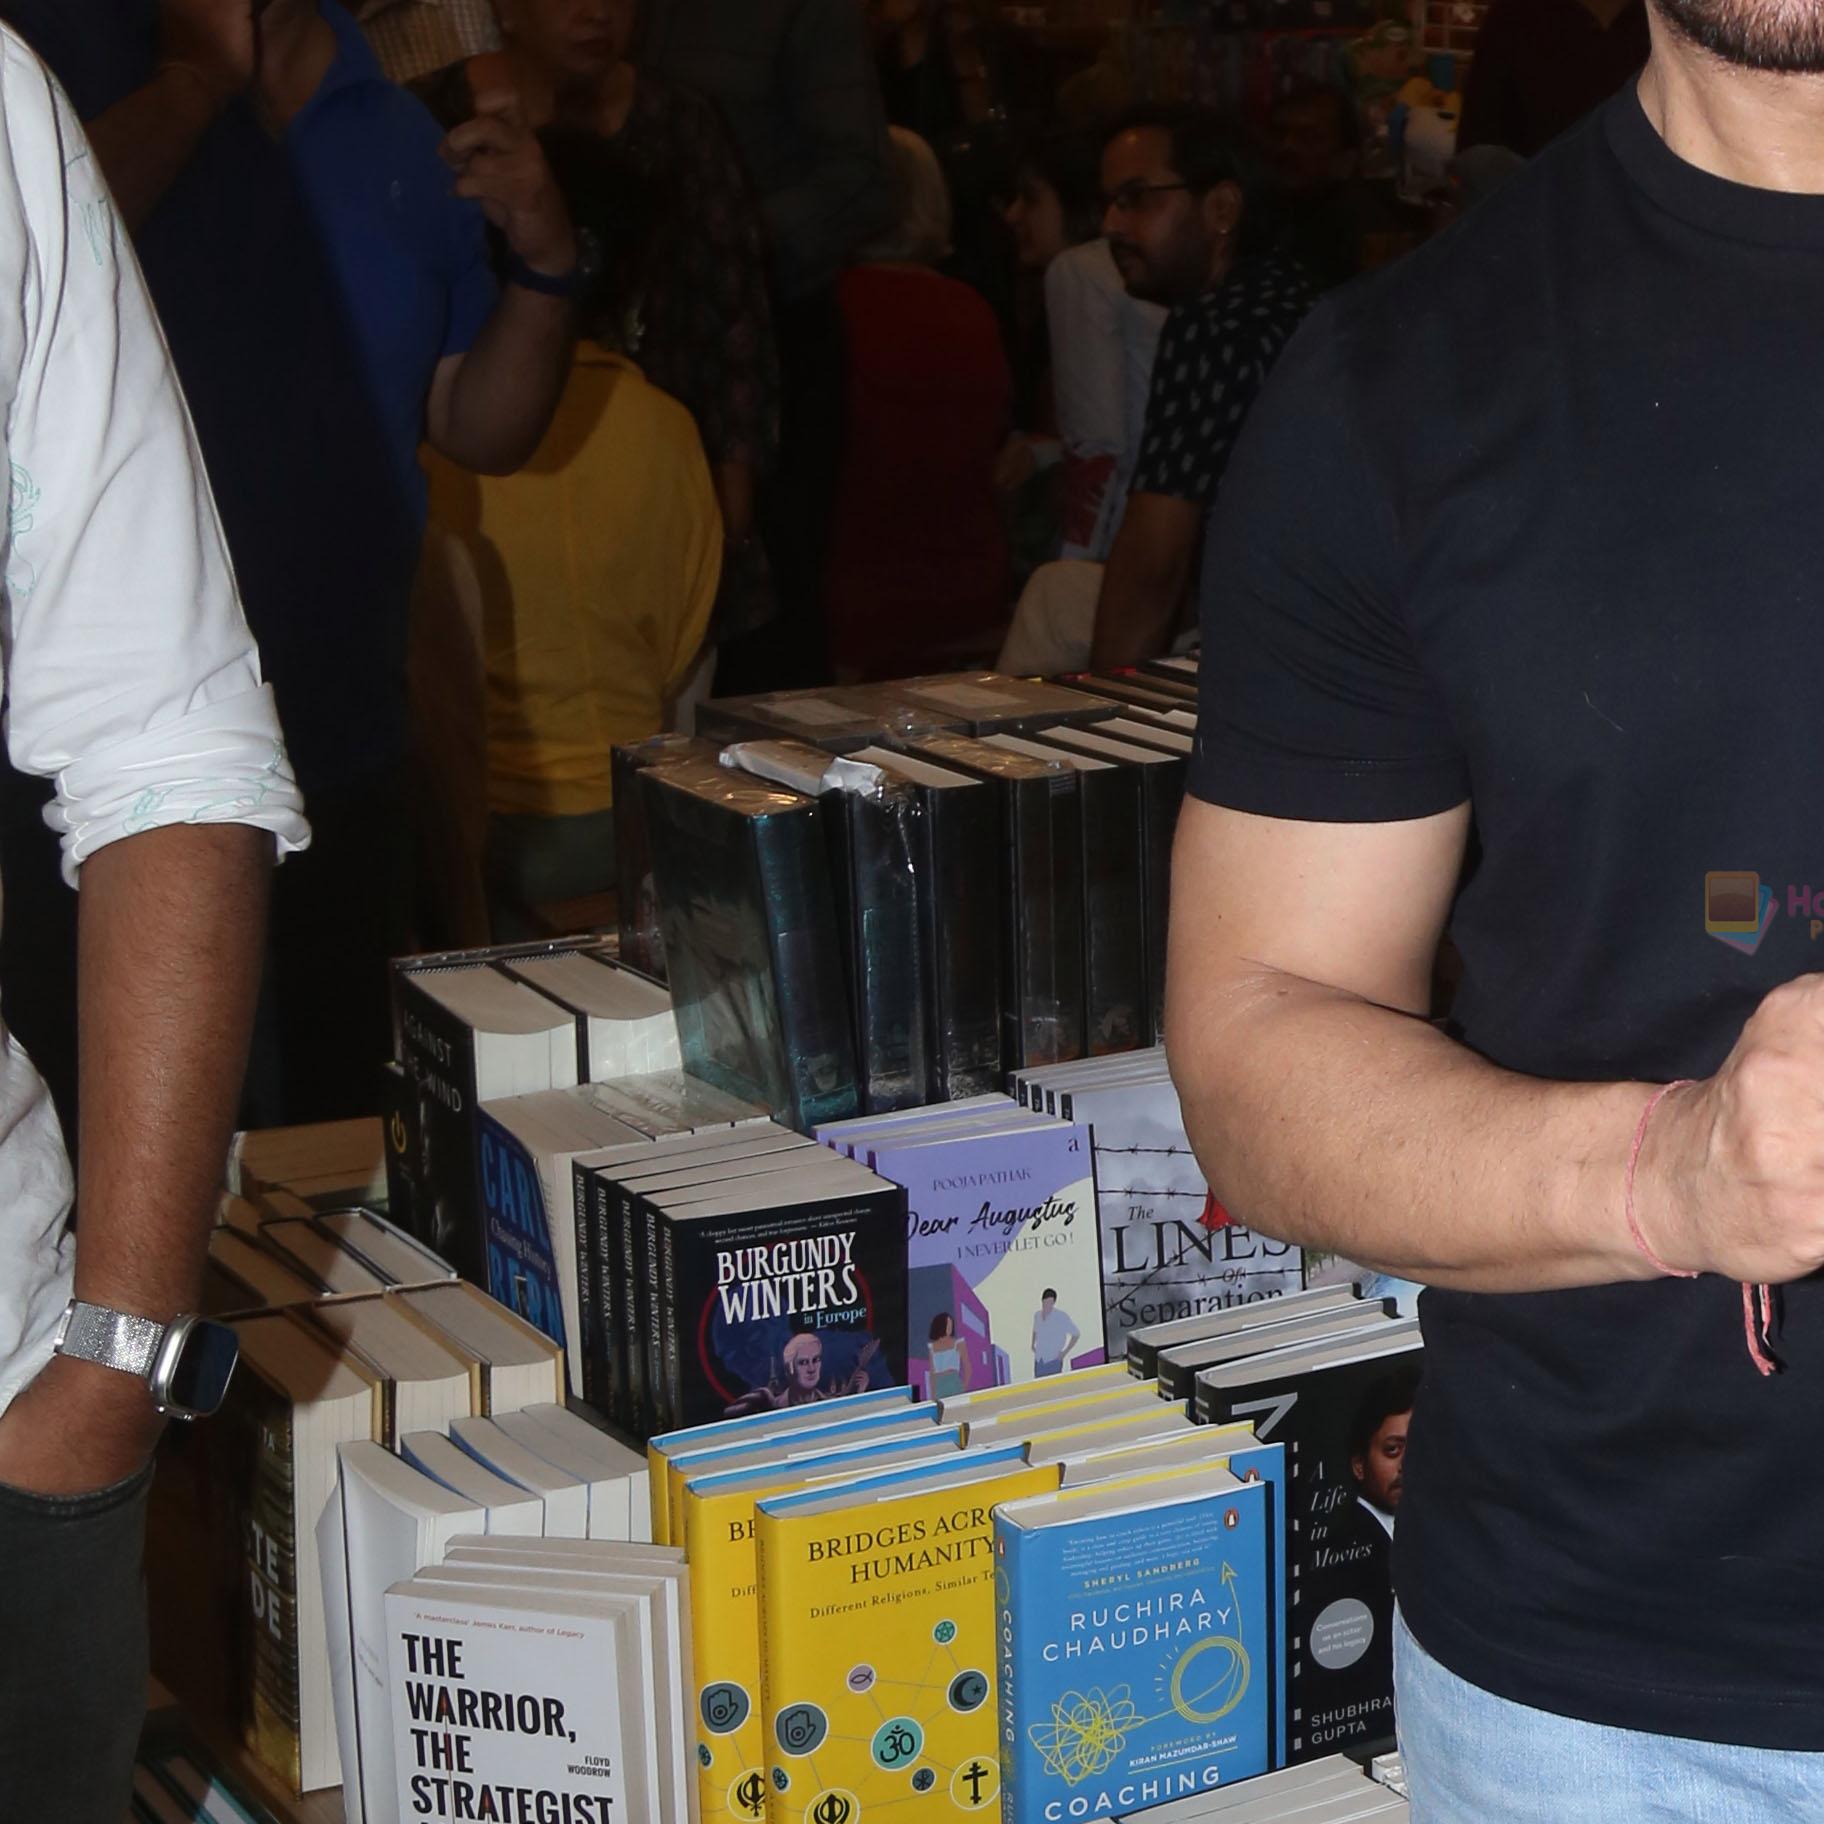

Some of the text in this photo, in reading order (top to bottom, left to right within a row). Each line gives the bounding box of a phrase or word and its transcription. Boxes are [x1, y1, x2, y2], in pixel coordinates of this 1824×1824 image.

[931, 1168, 1033, 1193] POOJA PATHAK
[905, 1213, 960, 1241] Dear
[967, 1195, 1079, 1236] Augustus
[1127, 1205, 1155, 1221] The
[716, 1231, 857, 1285] BURGUNDY
[962, 1241, 1013, 1259] NEVER
[1015, 1235, 1041, 1252] LET
[1043, 1232, 1066, 1248] GO
[1110, 1219, 1290, 1275] LINES
[718, 1264, 859, 1326] WINTERS
[803, 1306, 867, 1329] in Europe
[1309, 1459, 1326, 1483] A
[1309, 1484, 1348, 1516] Life
[807, 1519, 927, 1563] BRIDGES
[1309, 1520, 1329, 1542] in
[850, 1535, 996, 1585] HUMANITY
[1083, 1557, 1201, 1590] SHERYL SANDBERG
[1310, 1540, 1374, 1572] Movies
[809, 1574, 978, 1620] Different Religions, Similar
[1070, 1587, 1206, 1632] RUCHIRA
[1042, 1606, 1233, 1663] CHAUDHARY
[401, 1632, 466, 1679] THE
[405, 1680, 577, 1744] WARRIOR,
[1310, 1694, 1393, 1730] SHUBHRA
[410, 1727, 474, 1774] THE
[1310, 1719, 1368, 1747] GUPTA
[585, 1754, 611, 1768] FLOYD
[1129, 1735, 1239, 1768] KIRAN MAZUMDAR-SHAW
[567, 1764, 611, 1778] WOODROW
[1043, 1764, 1221, 1823] COACHING
